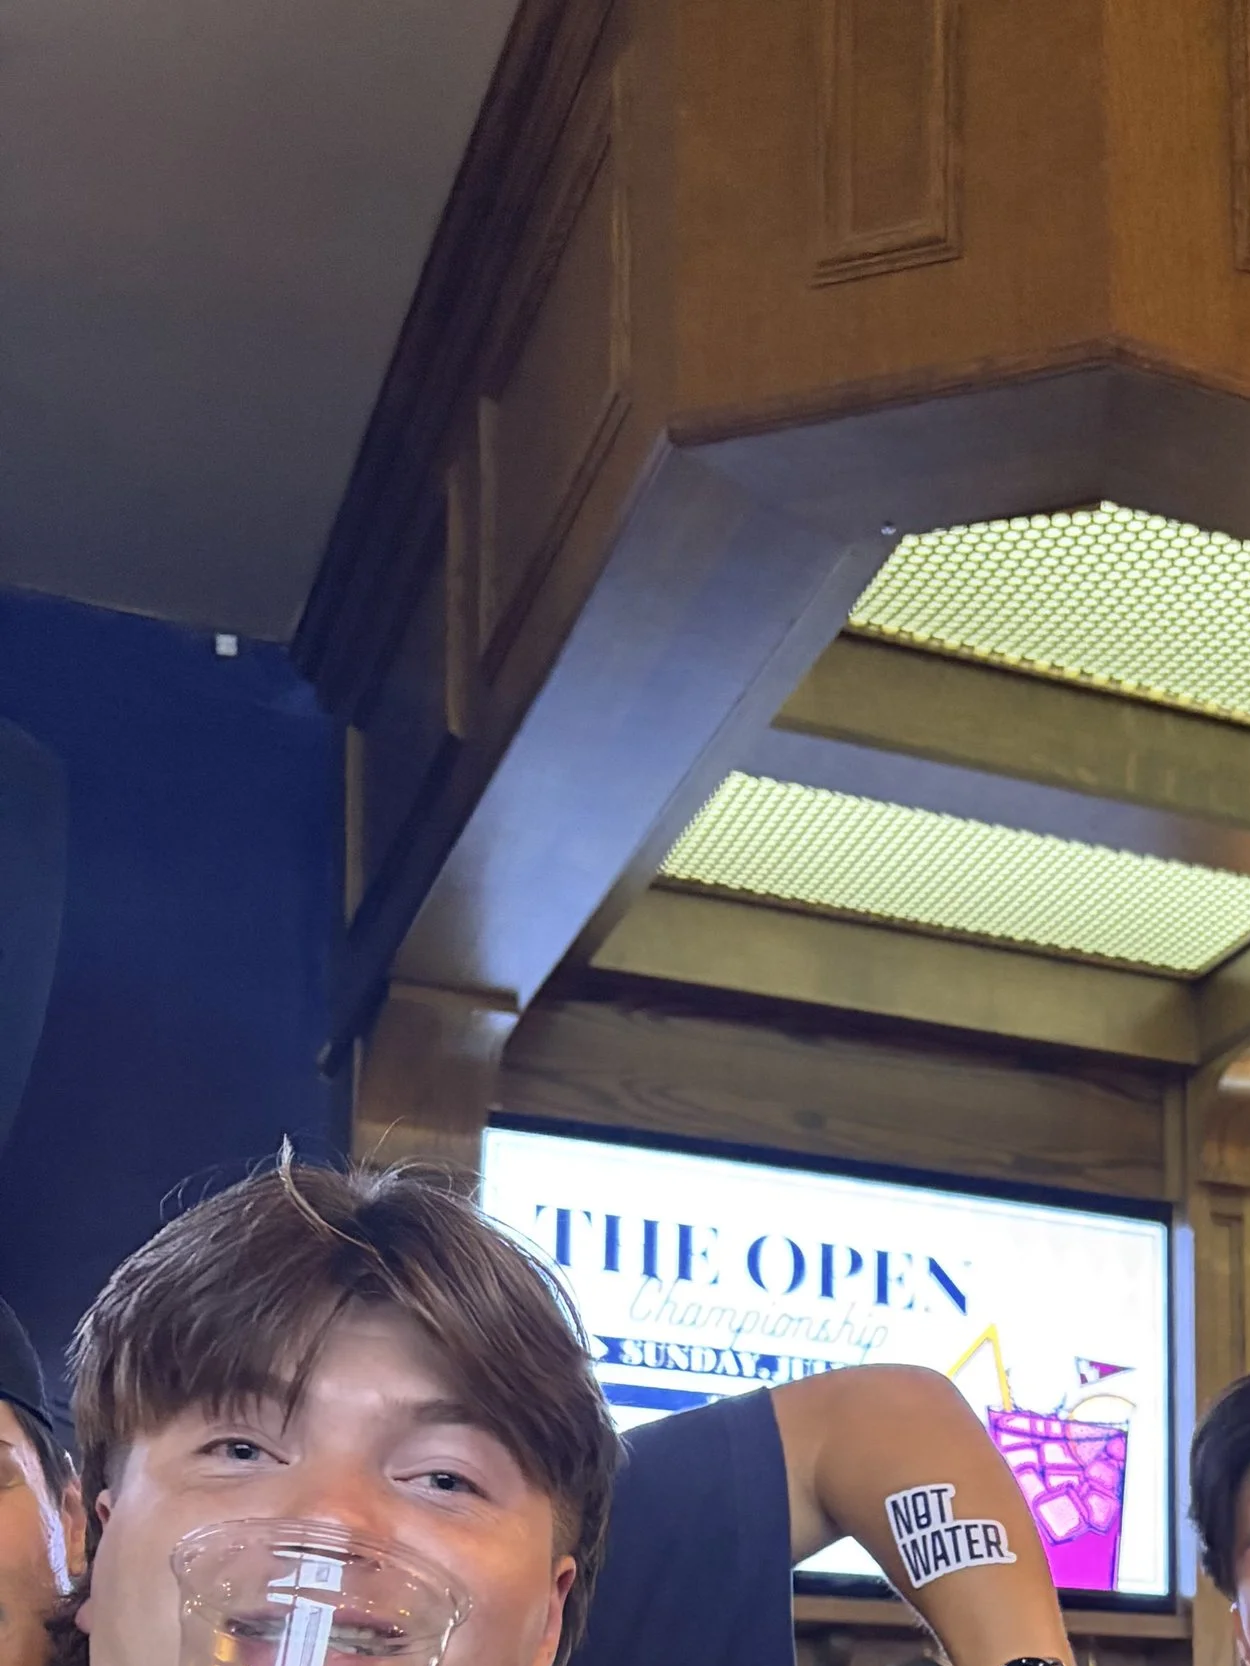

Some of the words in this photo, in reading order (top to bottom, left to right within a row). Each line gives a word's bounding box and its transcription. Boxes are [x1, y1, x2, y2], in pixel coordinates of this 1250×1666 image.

[536, 1204, 719, 1286] THE
[747, 1225, 972, 1317] OPEN
[629, 1272, 889, 1366] Championship
[891, 1488, 949, 1538] NOT
